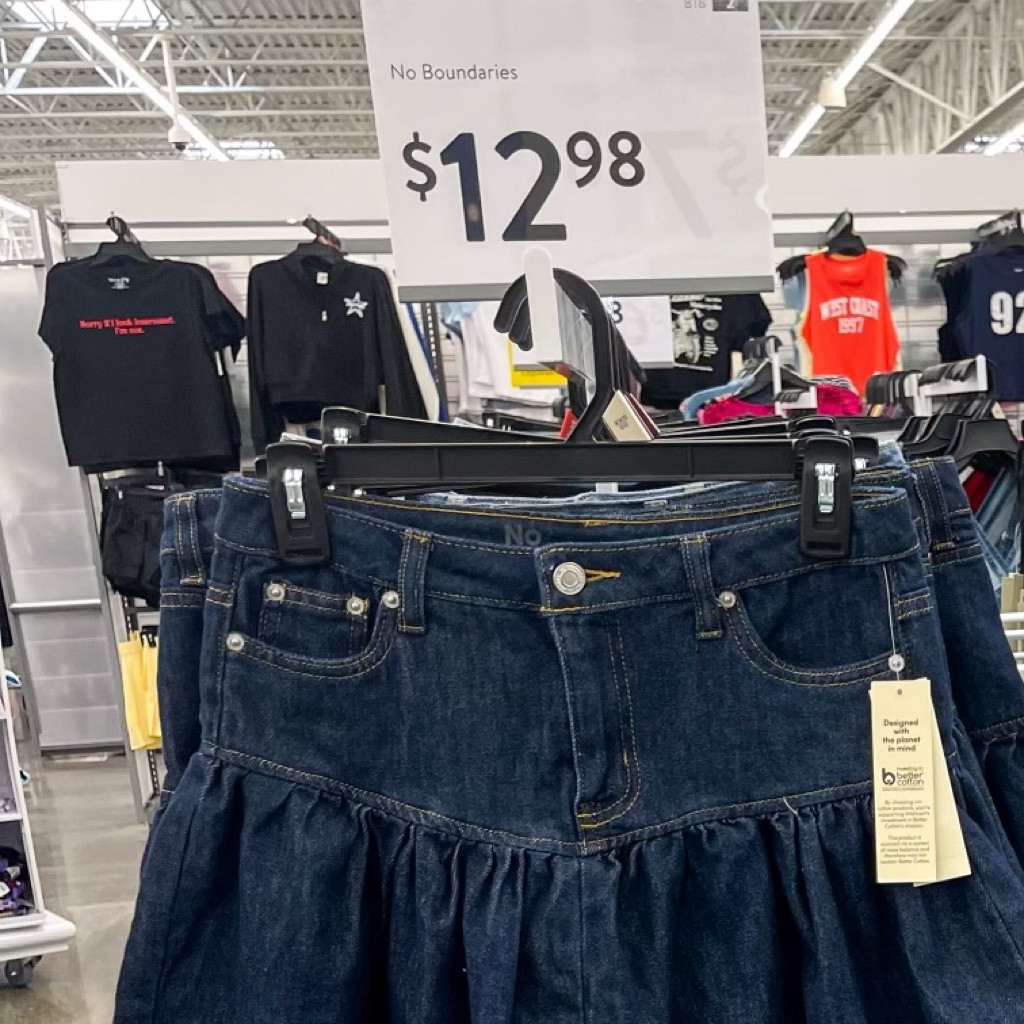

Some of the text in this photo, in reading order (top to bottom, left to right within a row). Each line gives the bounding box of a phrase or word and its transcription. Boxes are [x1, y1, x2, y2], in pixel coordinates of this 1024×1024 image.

[391, 64, 518, 80] No Boundaries
[819, 296, 879, 321] WEST COAST
[883, 718, 919, 727] Designed
[883, 736, 921, 745] the planet
[897, 744, 916, 752] mind
[897, 772, 923, 780] better
[897, 778, 924, 786] cotton
